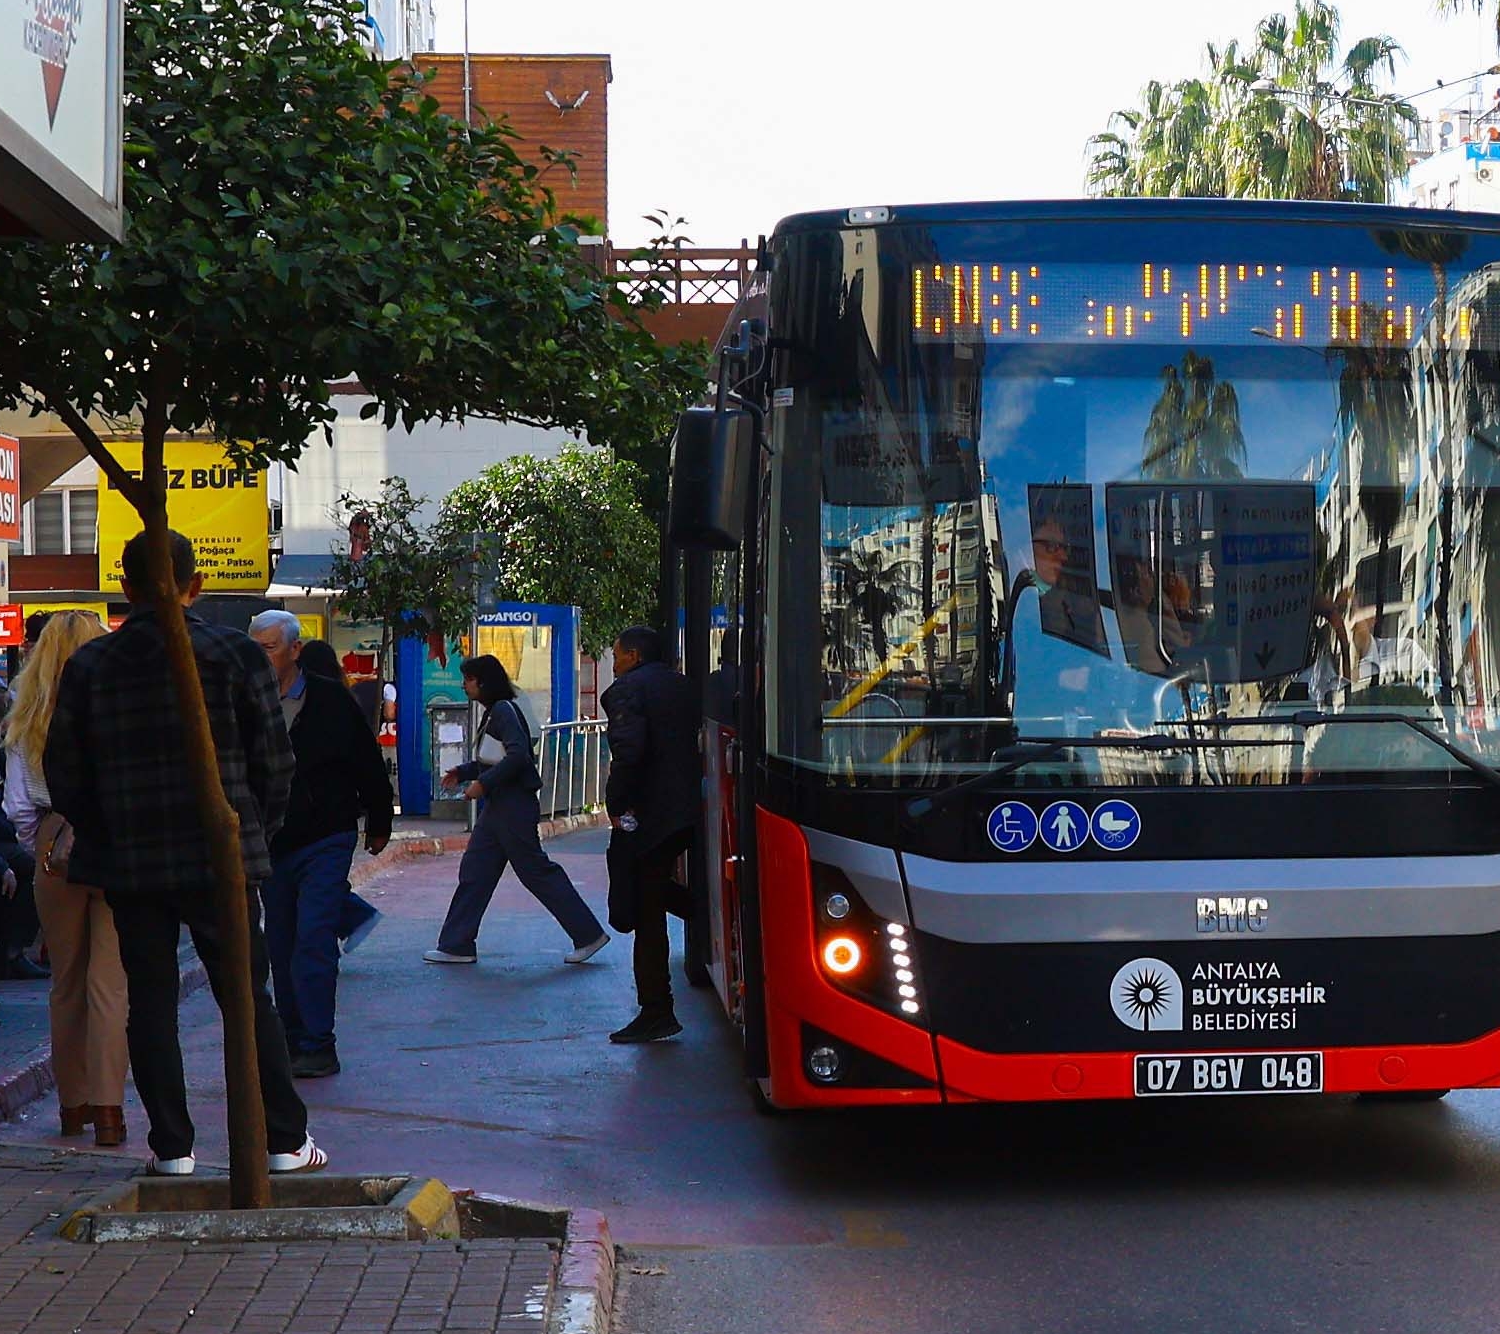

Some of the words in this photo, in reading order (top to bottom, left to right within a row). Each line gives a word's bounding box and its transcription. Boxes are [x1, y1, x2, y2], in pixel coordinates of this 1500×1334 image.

[199, 546, 235, 556] Poğaça
[227, 558, 254, 567] Patso
[217, 570, 263, 581] Meşrubat
[1197, 897, 1268, 933] BMC
[1192, 962, 1281, 980] ANTALYA
[1192, 982, 1326, 1009] BÜYÜKŞEHİR
[1192, 1008, 1296, 1031] BELEDİYESİ
[1147, 1060, 1181, 1091] 07
[1193, 1058, 1244, 1090] BGV
[1262, 1057, 1312, 1089] 048
